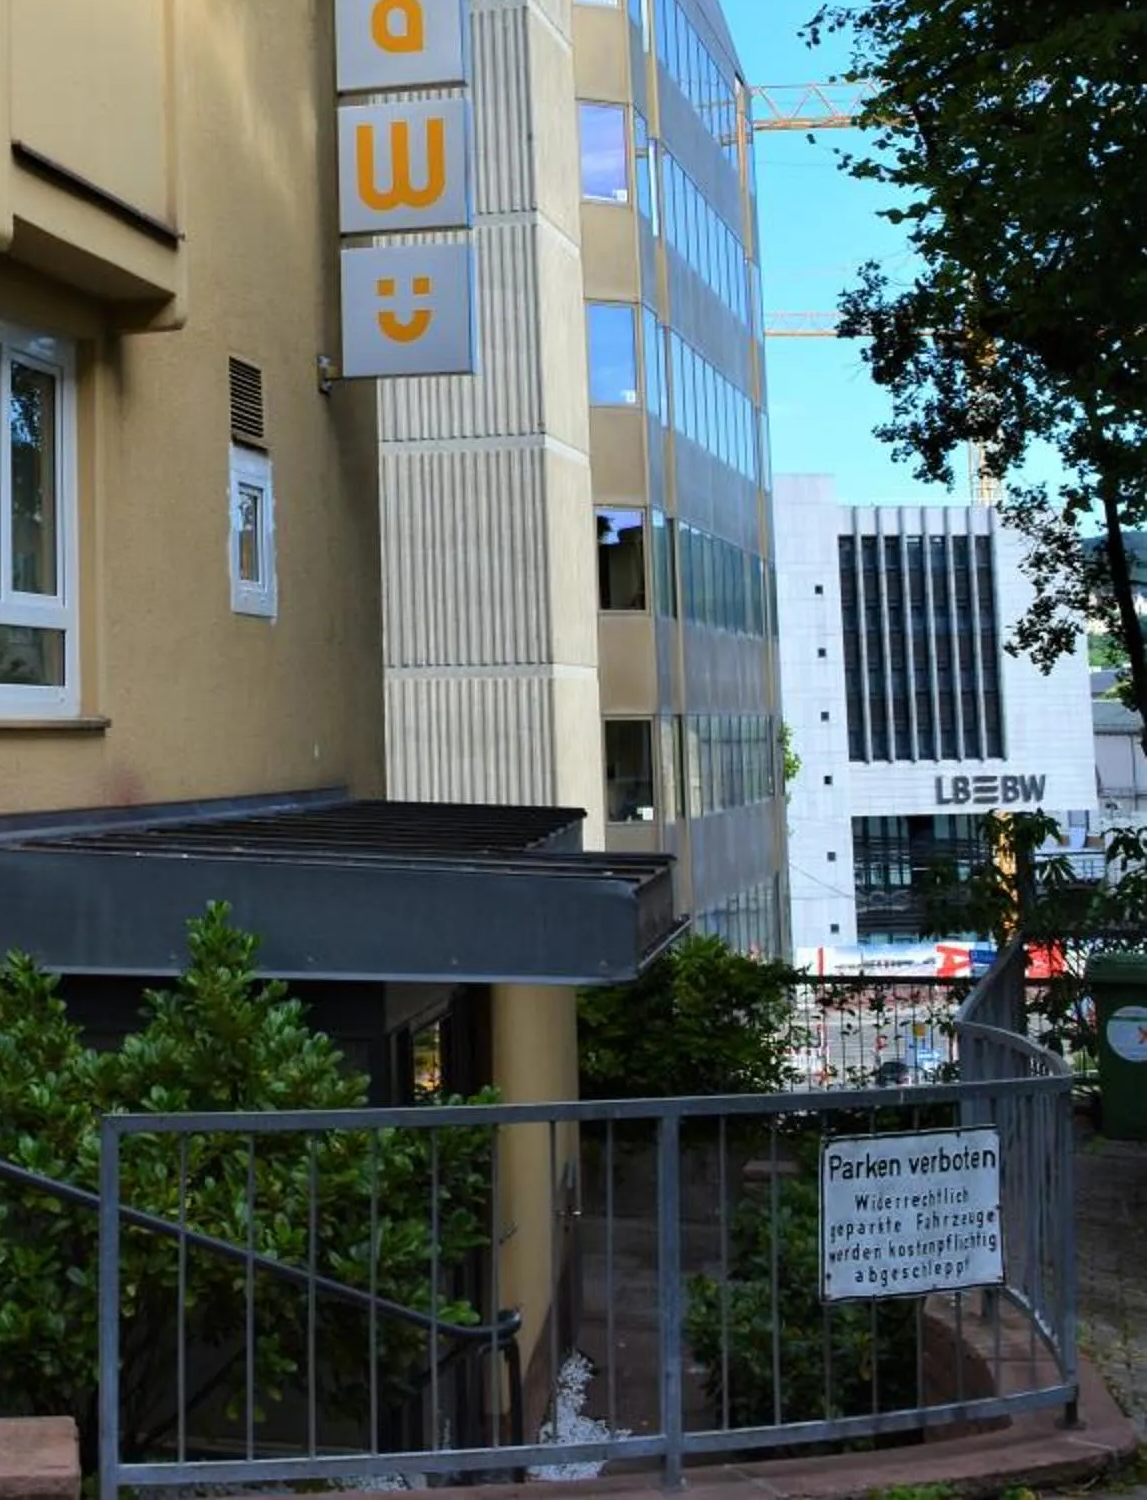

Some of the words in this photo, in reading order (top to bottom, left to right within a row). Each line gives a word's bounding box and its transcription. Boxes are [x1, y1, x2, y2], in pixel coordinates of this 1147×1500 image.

[829, 1152, 902, 1181] Parken
[908, 1146, 996, 1175] verboten
[854, 1187, 969, 1211] Widerrechtlich
[829, 1215, 902, 1243] geparkte
[916, 1210, 995, 1231] Fahrzeuge
[829, 1243, 883, 1262] werden
